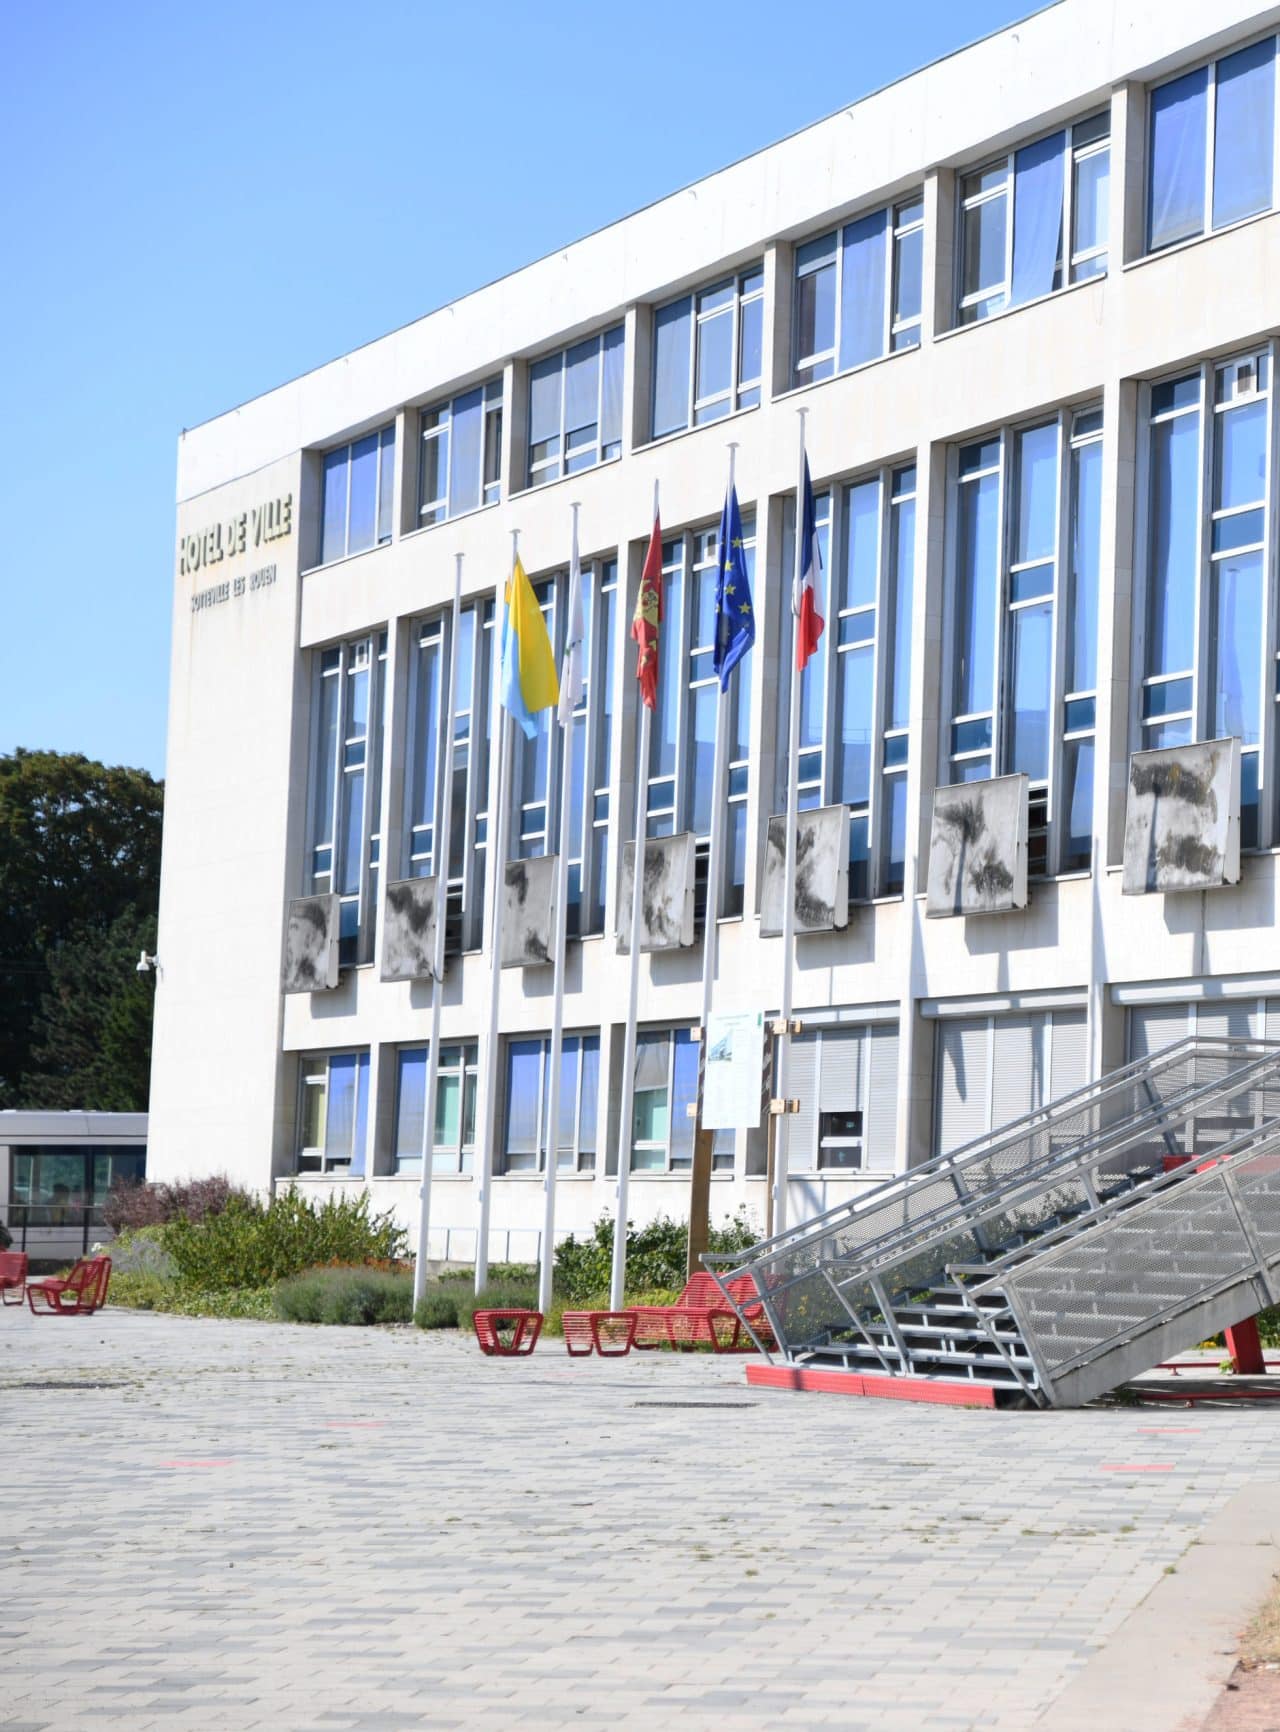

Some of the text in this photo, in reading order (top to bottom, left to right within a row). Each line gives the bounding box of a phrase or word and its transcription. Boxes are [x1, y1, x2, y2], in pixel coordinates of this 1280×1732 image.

[179, 492, 293, 577] HOTEL DE VILLE
